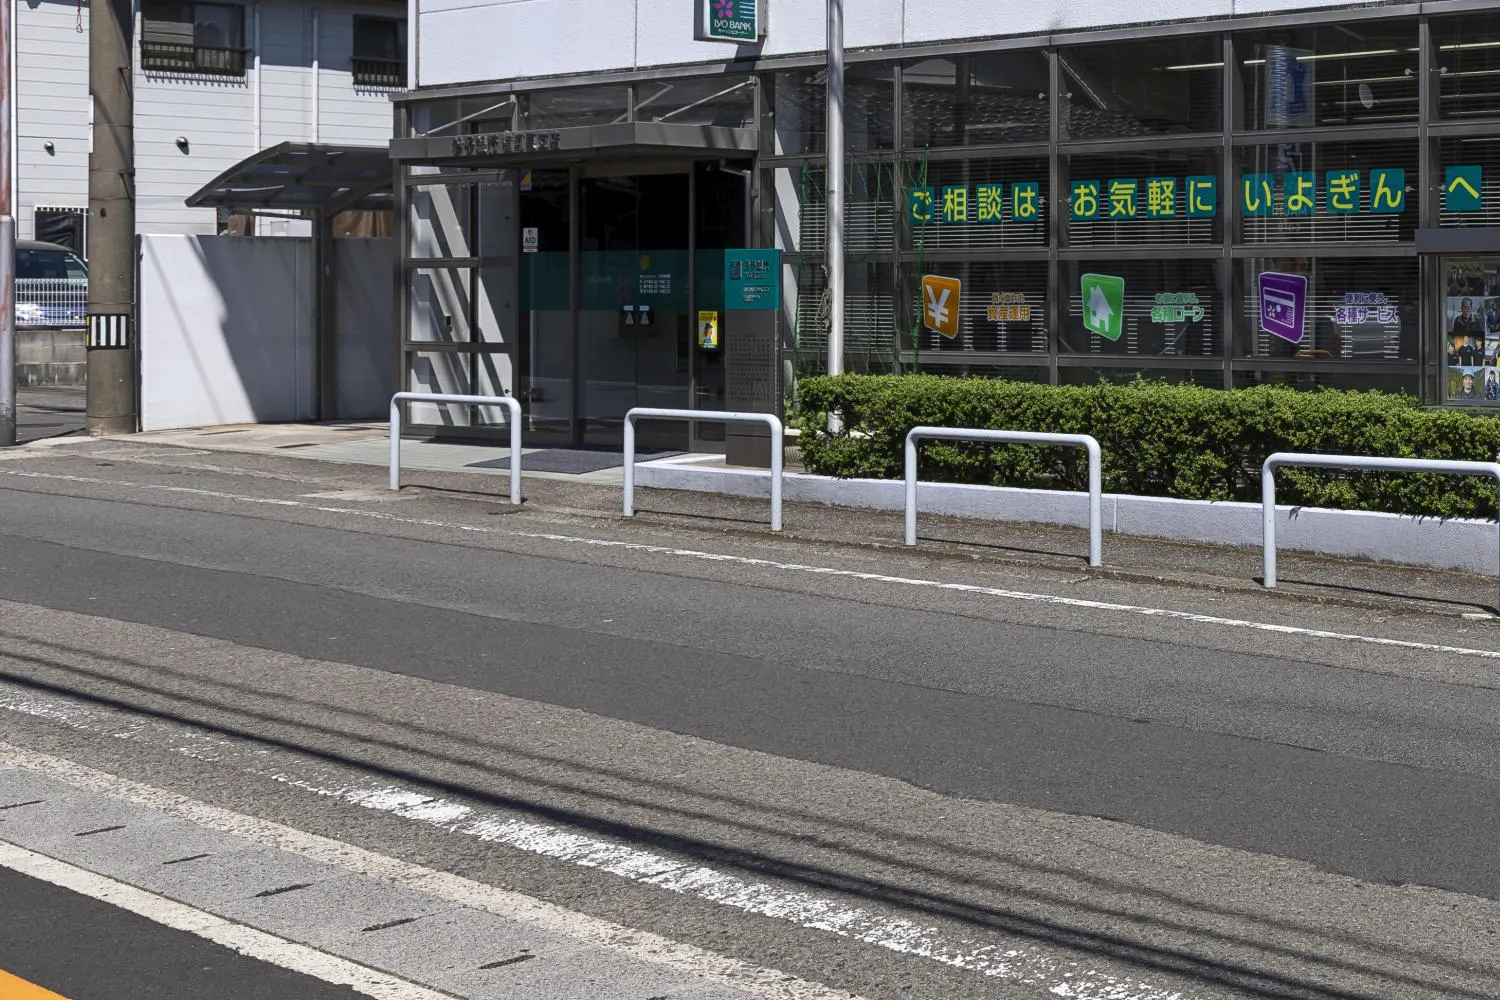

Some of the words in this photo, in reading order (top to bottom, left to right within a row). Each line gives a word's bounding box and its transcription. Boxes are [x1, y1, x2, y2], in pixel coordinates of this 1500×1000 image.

[714, 19, 728, 28] IYO
[729, 20, 751, 30] BANK
[912, 185, 1037, 222] ご相談は
[1073, 180, 1213, 217] お気軽に
[1245, 172, 1402, 211] いよぎん
[1448, 176, 1479, 199] へ
[987, 305, 1030, 321] 資産運用
[1151, 305, 1204, 322] 各種ローン
[1335, 306, 1398, 324] 各種サービス
